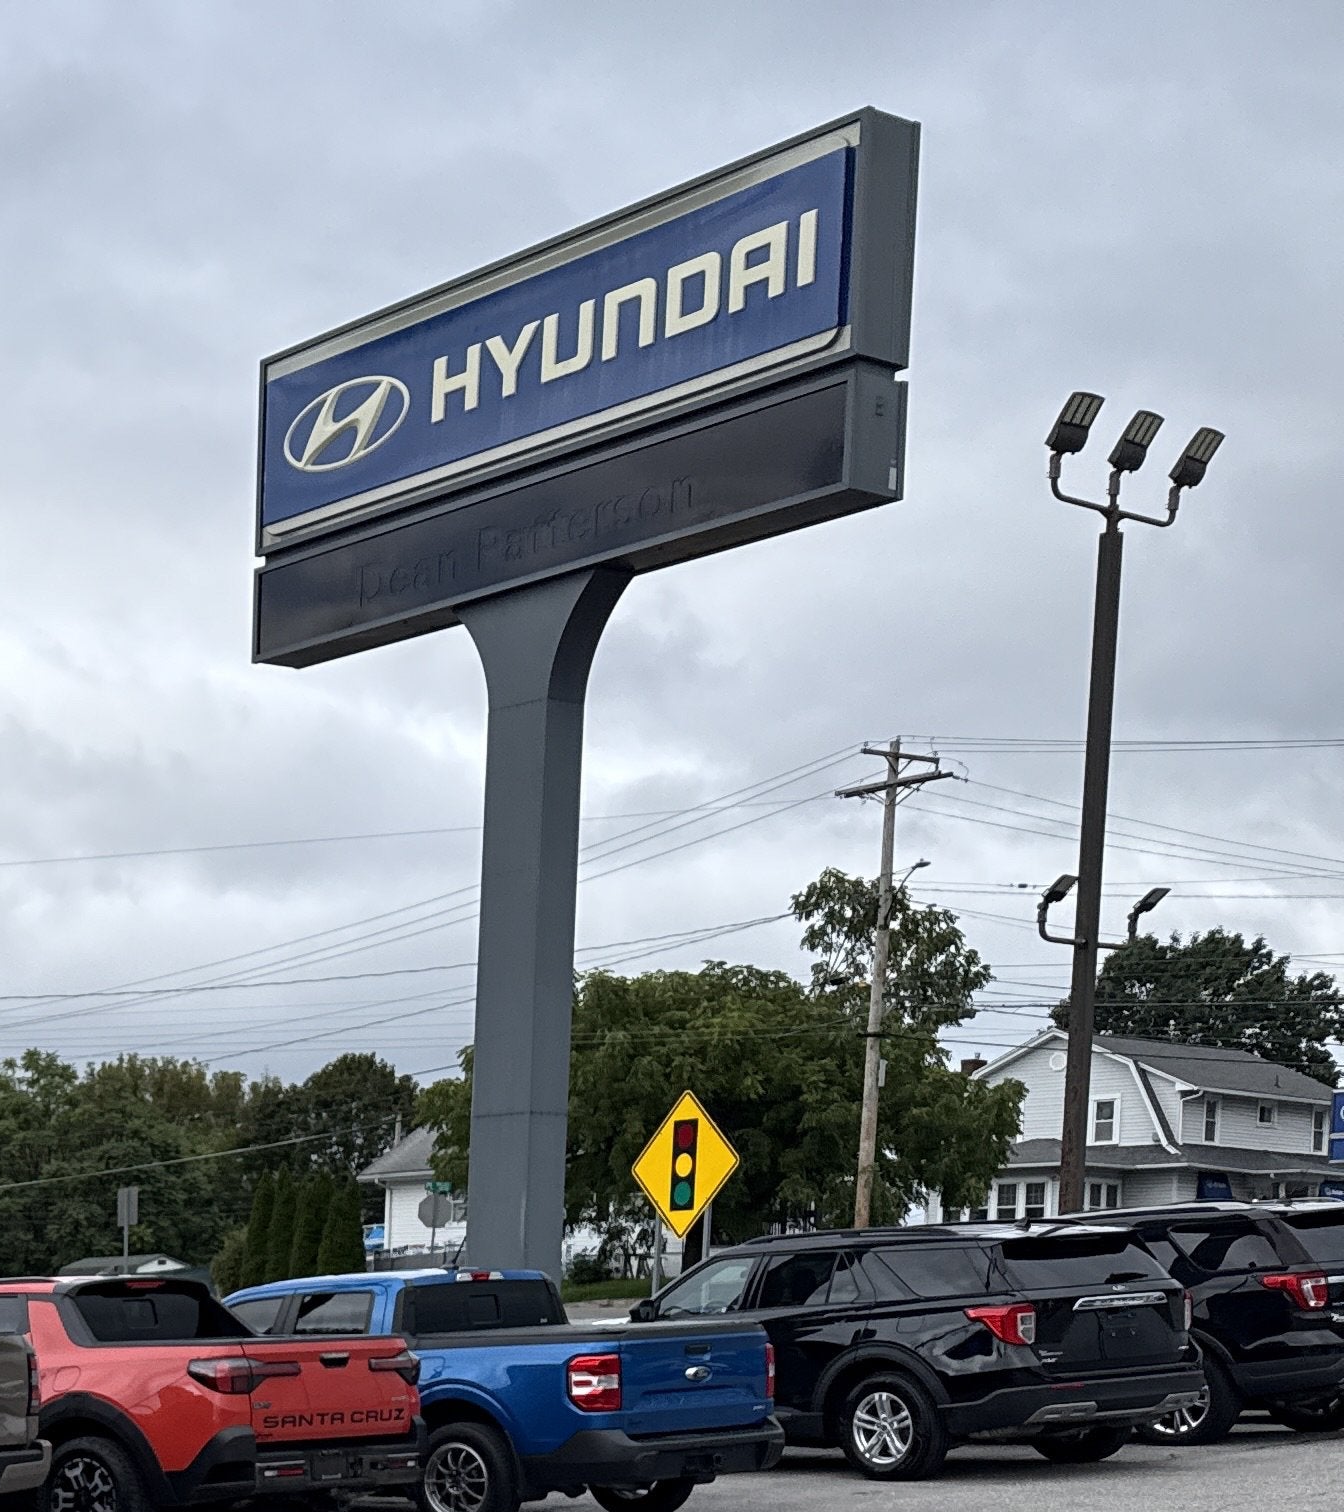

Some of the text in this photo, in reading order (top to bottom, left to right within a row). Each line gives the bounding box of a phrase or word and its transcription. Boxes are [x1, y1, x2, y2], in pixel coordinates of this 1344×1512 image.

[430, 208, 819, 424] HYUNDAI
[263, 1407, 406, 1429] SANTA CRUZ
